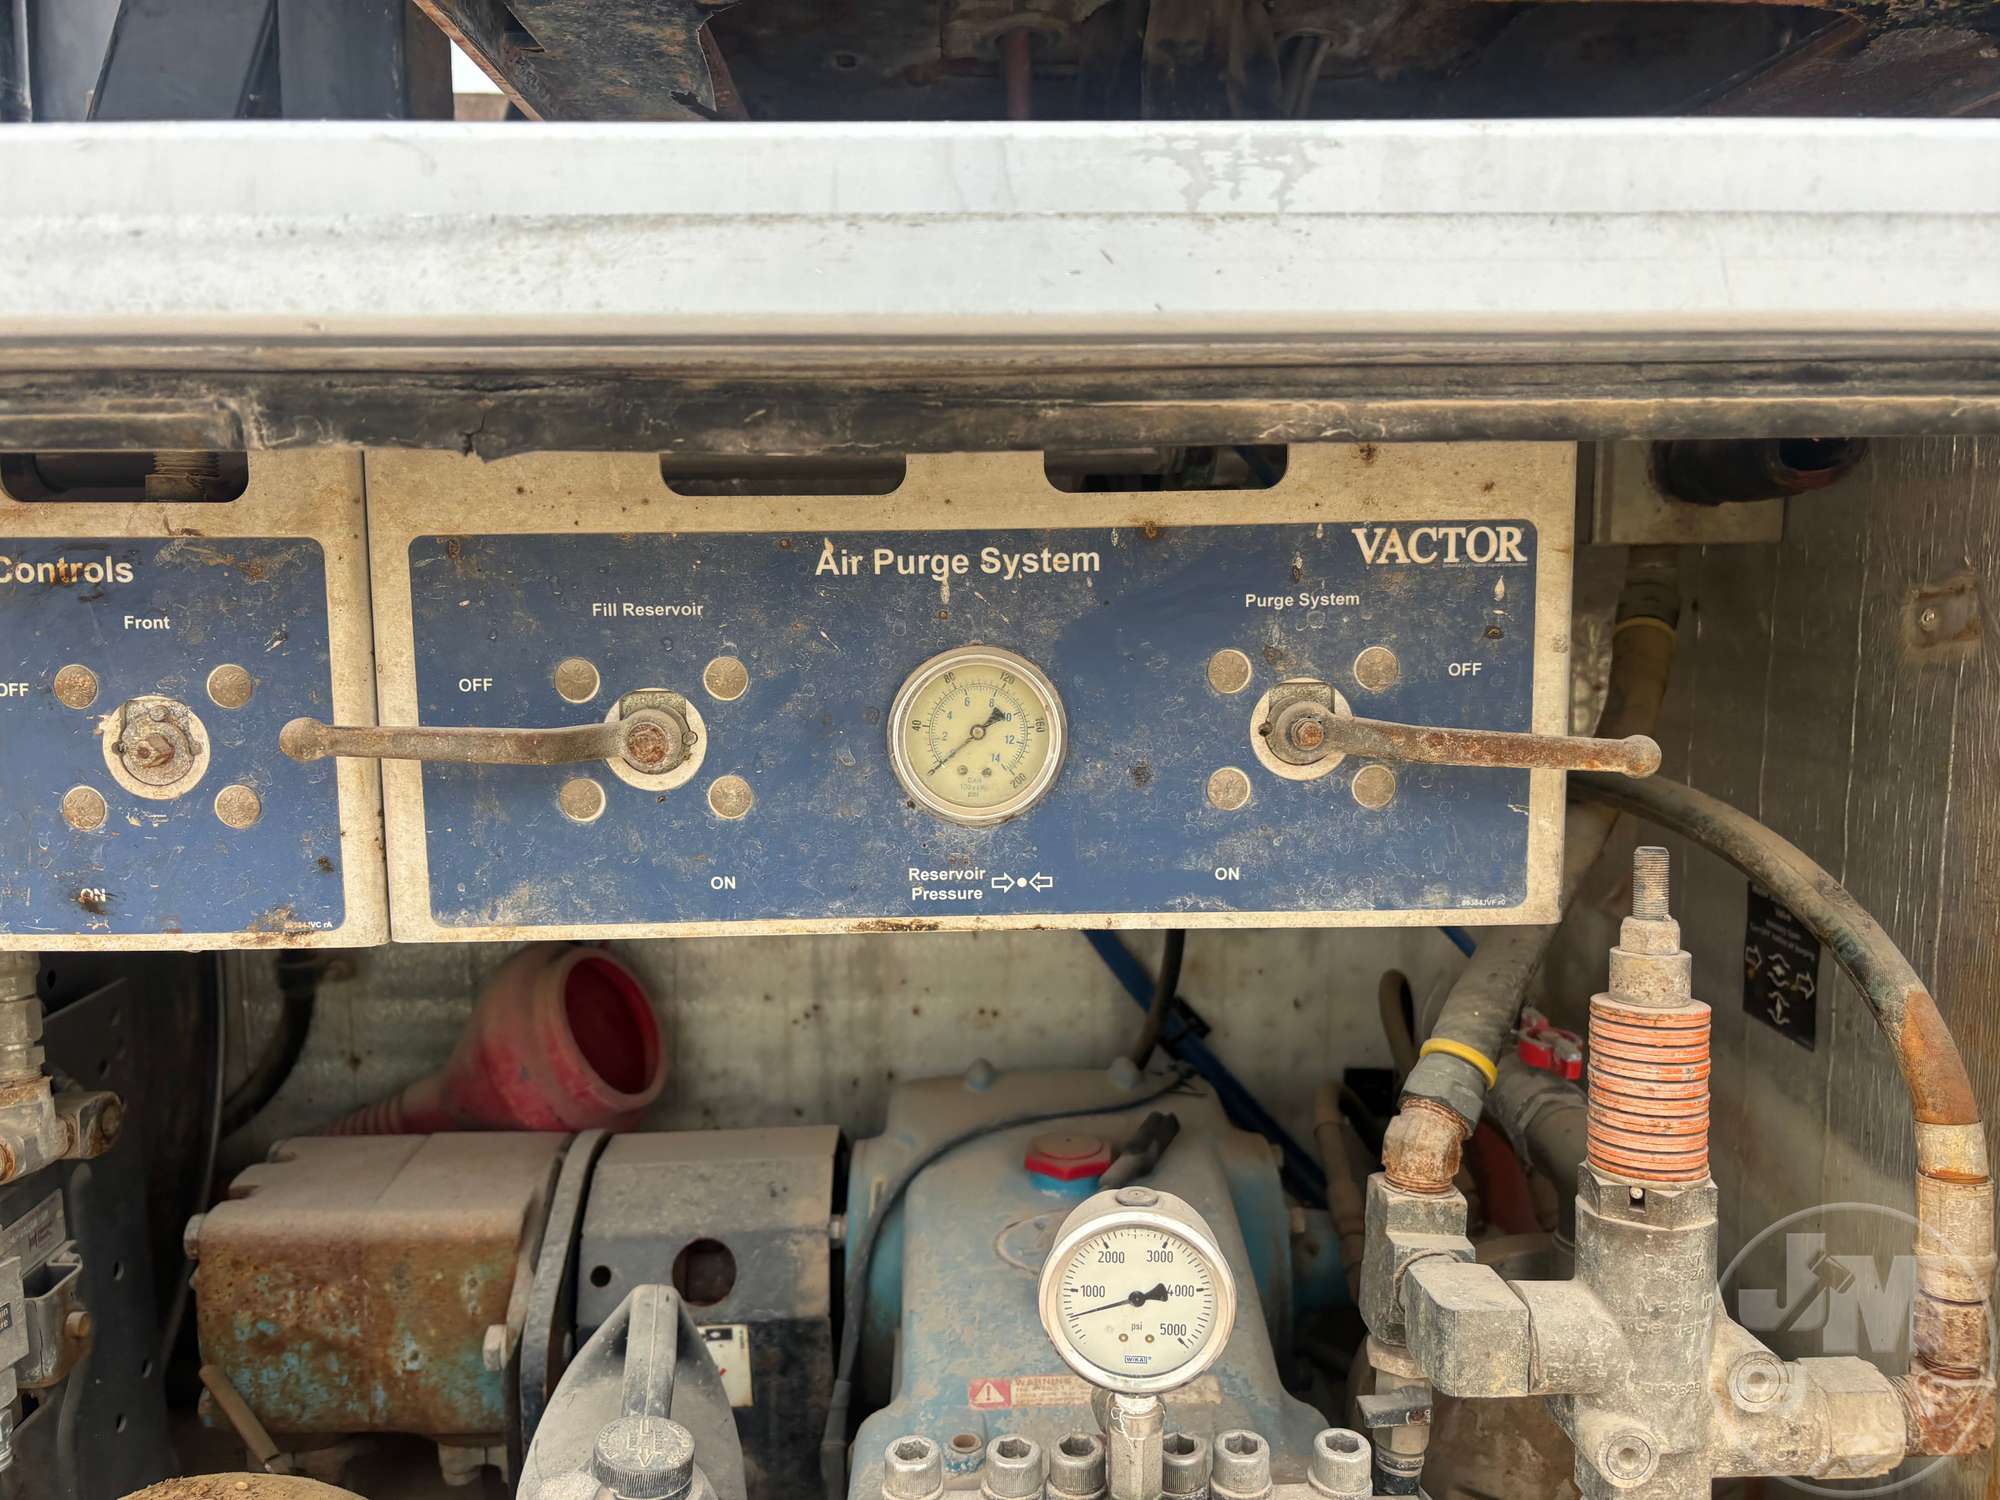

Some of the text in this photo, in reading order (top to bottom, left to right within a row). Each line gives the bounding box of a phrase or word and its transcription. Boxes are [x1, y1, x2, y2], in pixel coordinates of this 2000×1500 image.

[1352, 526, 1527, 565] VACTOR
[815, 547, 1100, 581] Air Purge System
[1245, 592, 1360, 609] Purge System
[592, 602, 704, 617] Fill Reservoir
[123, 615, 170, 631] Front
[1448, 662, 1482, 677] OFF
[944, 672, 955, 683] 80
[1000, 672, 1015, 684] 120
[459, 678, 493, 692] OFF
[911, 719, 922, 732] 40
[1005, 735, 1015, 744] 12
[992, 753, 1000, 762] 14
[1010, 773, 1026, 789] 200
[908, 867, 986, 881] Reservoir
[1215, 867, 1240, 880] ON
[711, 876, 736, 890] ON
[911, 888, 983, 900] Pressure
[1098, 1250, 1125, 1264] 2000
[1146, 1249, 1174, 1263] 3000
[1081, 1284, 1106, 1298] 1000
[1167, 1284, 1195, 1297] 4000
[1131, 1321, 1143, 1332] psi
[1160, 1323, 1187, 1336] 5000
